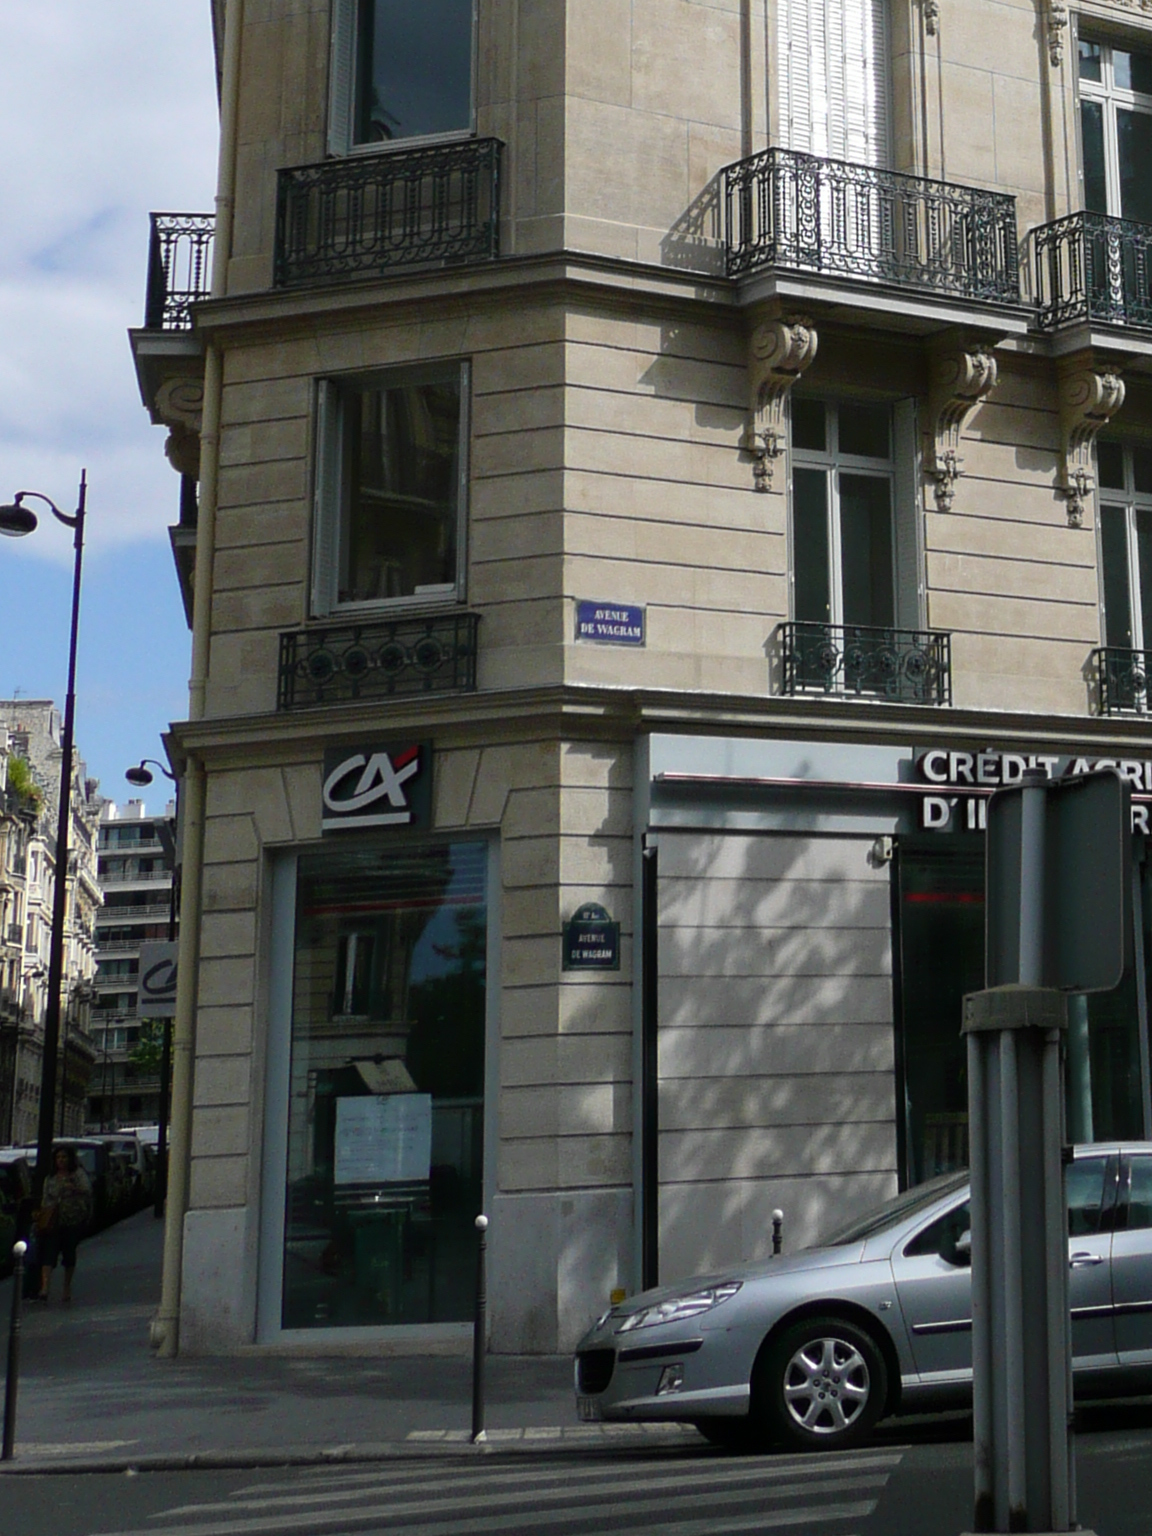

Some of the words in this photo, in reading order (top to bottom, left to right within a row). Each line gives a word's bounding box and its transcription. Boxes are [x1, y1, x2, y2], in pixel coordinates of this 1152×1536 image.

[594, 609, 629, 622] AVENUE
[580, 623, 594, 634] DE
[597, 624, 641, 637] WAGRAM
[323, 745, 418, 812] CA
[578, 934, 605, 943] AVENUE
[571, 950, 581, 959] DE
[582, 950, 612, 959] WAGRAM
